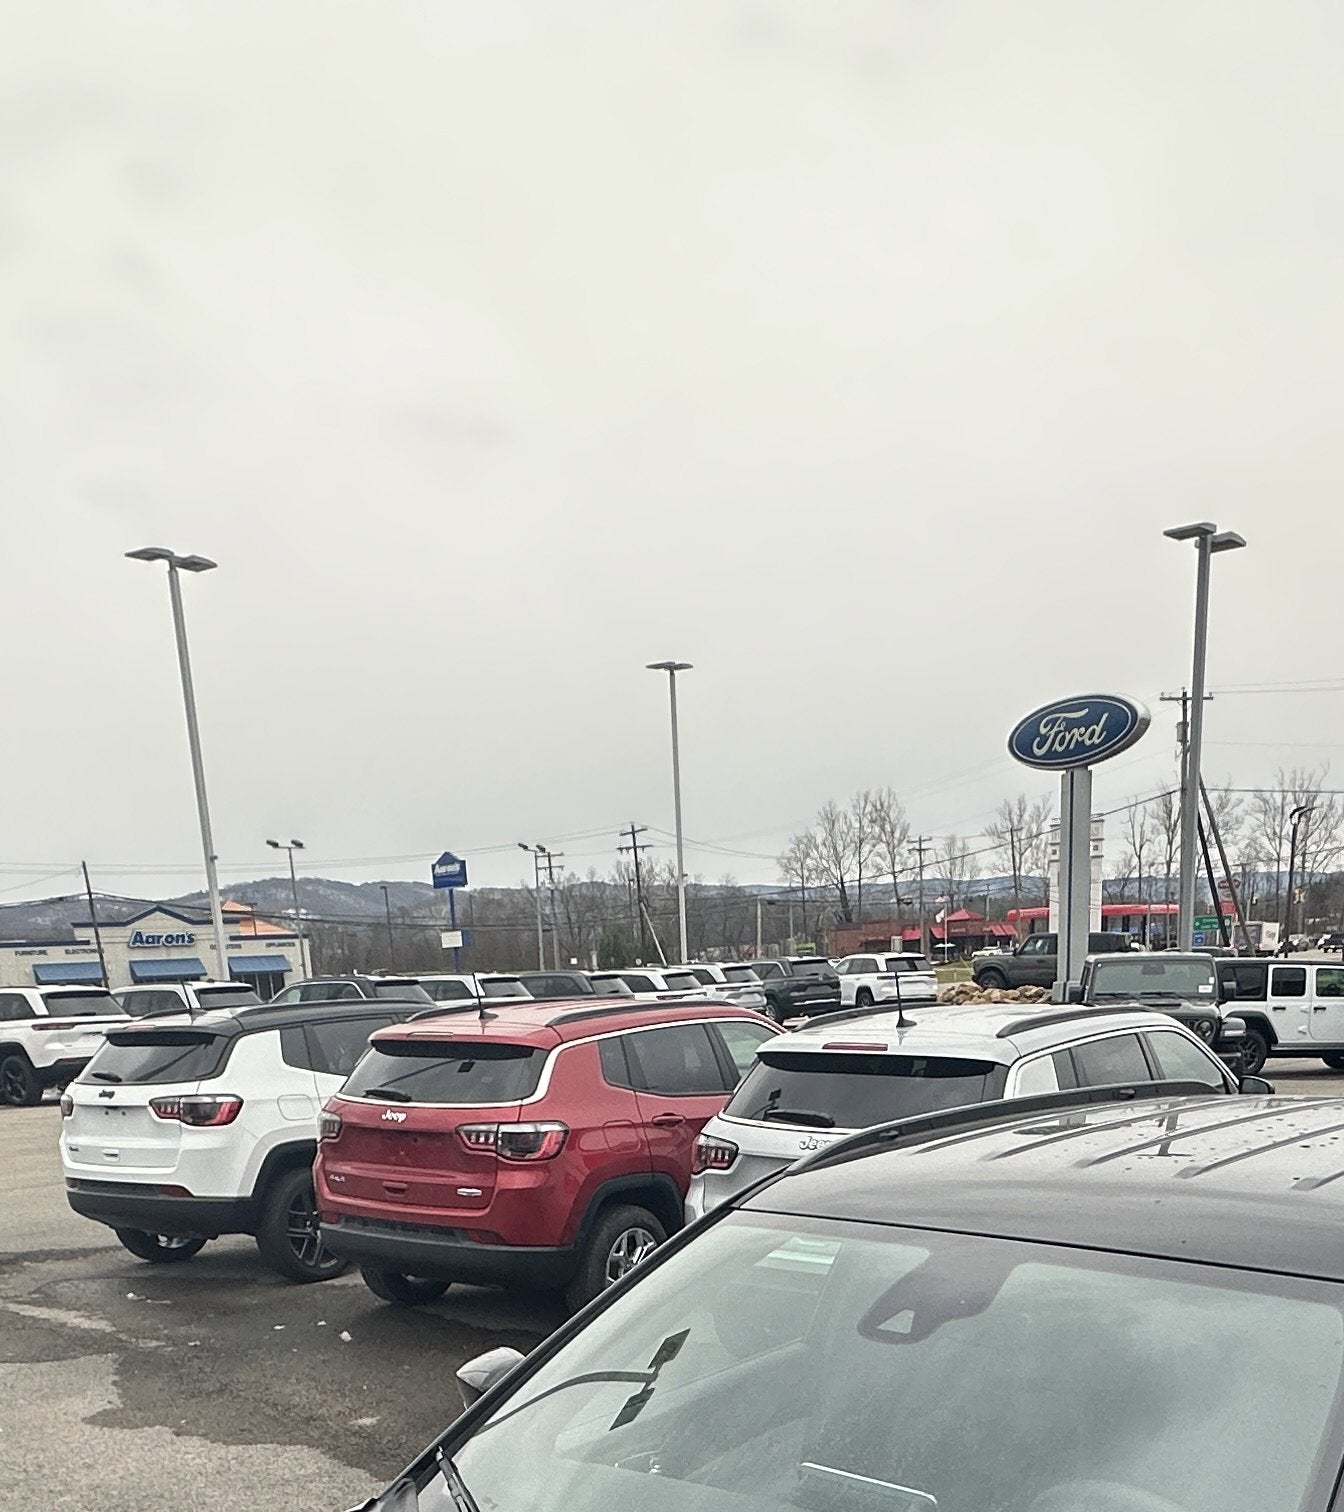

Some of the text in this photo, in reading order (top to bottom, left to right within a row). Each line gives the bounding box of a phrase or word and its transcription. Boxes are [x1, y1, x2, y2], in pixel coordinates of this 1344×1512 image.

[1032, 707, 1109, 757] Ford
[130, 930, 196, 947] Aaron's
[381, 1109, 407, 1123] Jeep
[799, 1135, 833, 1151] Jee
